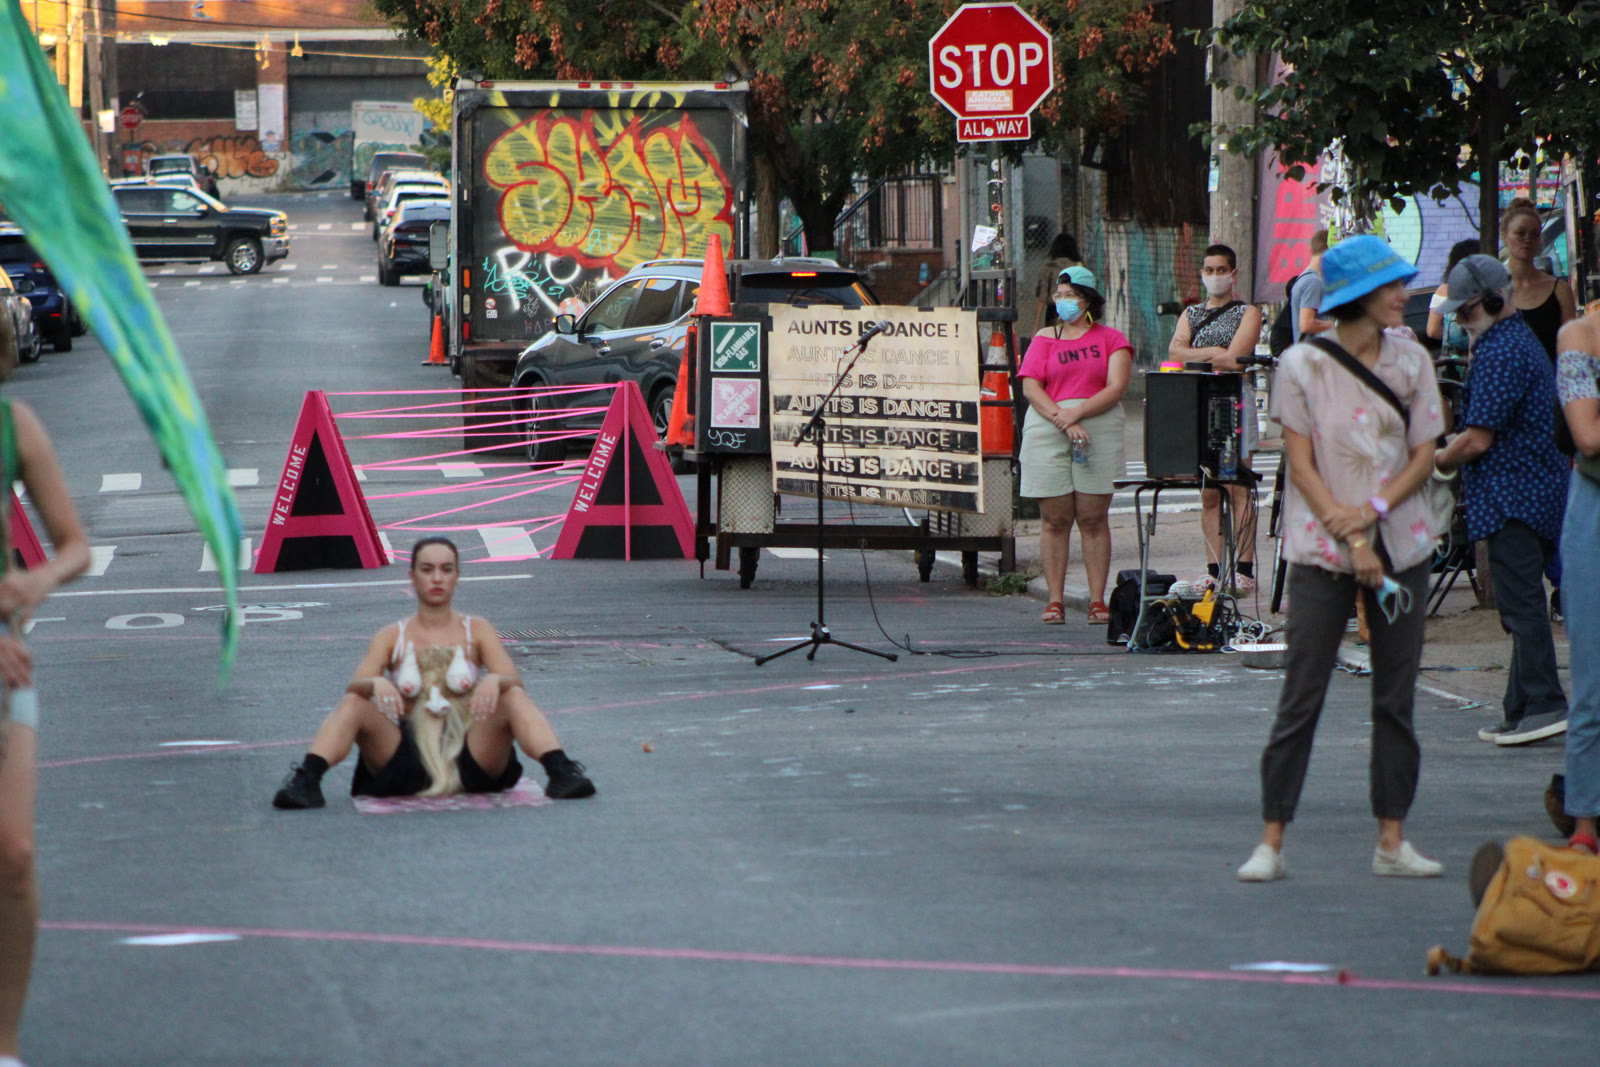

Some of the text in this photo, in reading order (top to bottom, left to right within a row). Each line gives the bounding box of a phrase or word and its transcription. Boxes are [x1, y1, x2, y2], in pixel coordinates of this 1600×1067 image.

[939, 42, 1043, 89] STOP
[996, 120, 1024, 135] WAY
[788, 320, 852, 336] AUNTS
[858, 321, 877, 337] IS
[882, 322, 948, 338] DANCE
[715, 326, 757, 368] NON-FLAMMABLE
[735, 347, 749, 361] GAS
[787, 345, 852, 363] AUNTS
[858, 348, 876, 364] IS
[882, 349, 949, 366] DANCE
[749, 360, 757, 369] 2
[859, 373, 877, 389] IS
[716, 384, 756, 422] FLAMMABLE
[735, 402, 750, 417] GAS
[787, 395, 854, 414] AUNTS
[859, 397, 878, 415] IS
[883, 399, 951, 418] DANCE
[789, 426, 853, 443] AUNTS
[860, 428, 878, 444] IS
[884, 430, 950, 447] DANCE
[574, 432, 616, 513] WELCOME
[790, 456, 855, 473] AUNTS
[860, 457, 879, 475] IS
[886, 459, 951, 478] DANCE
[273, 444, 306, 526] WELCOME
[861, 486, 880, 499] IS
